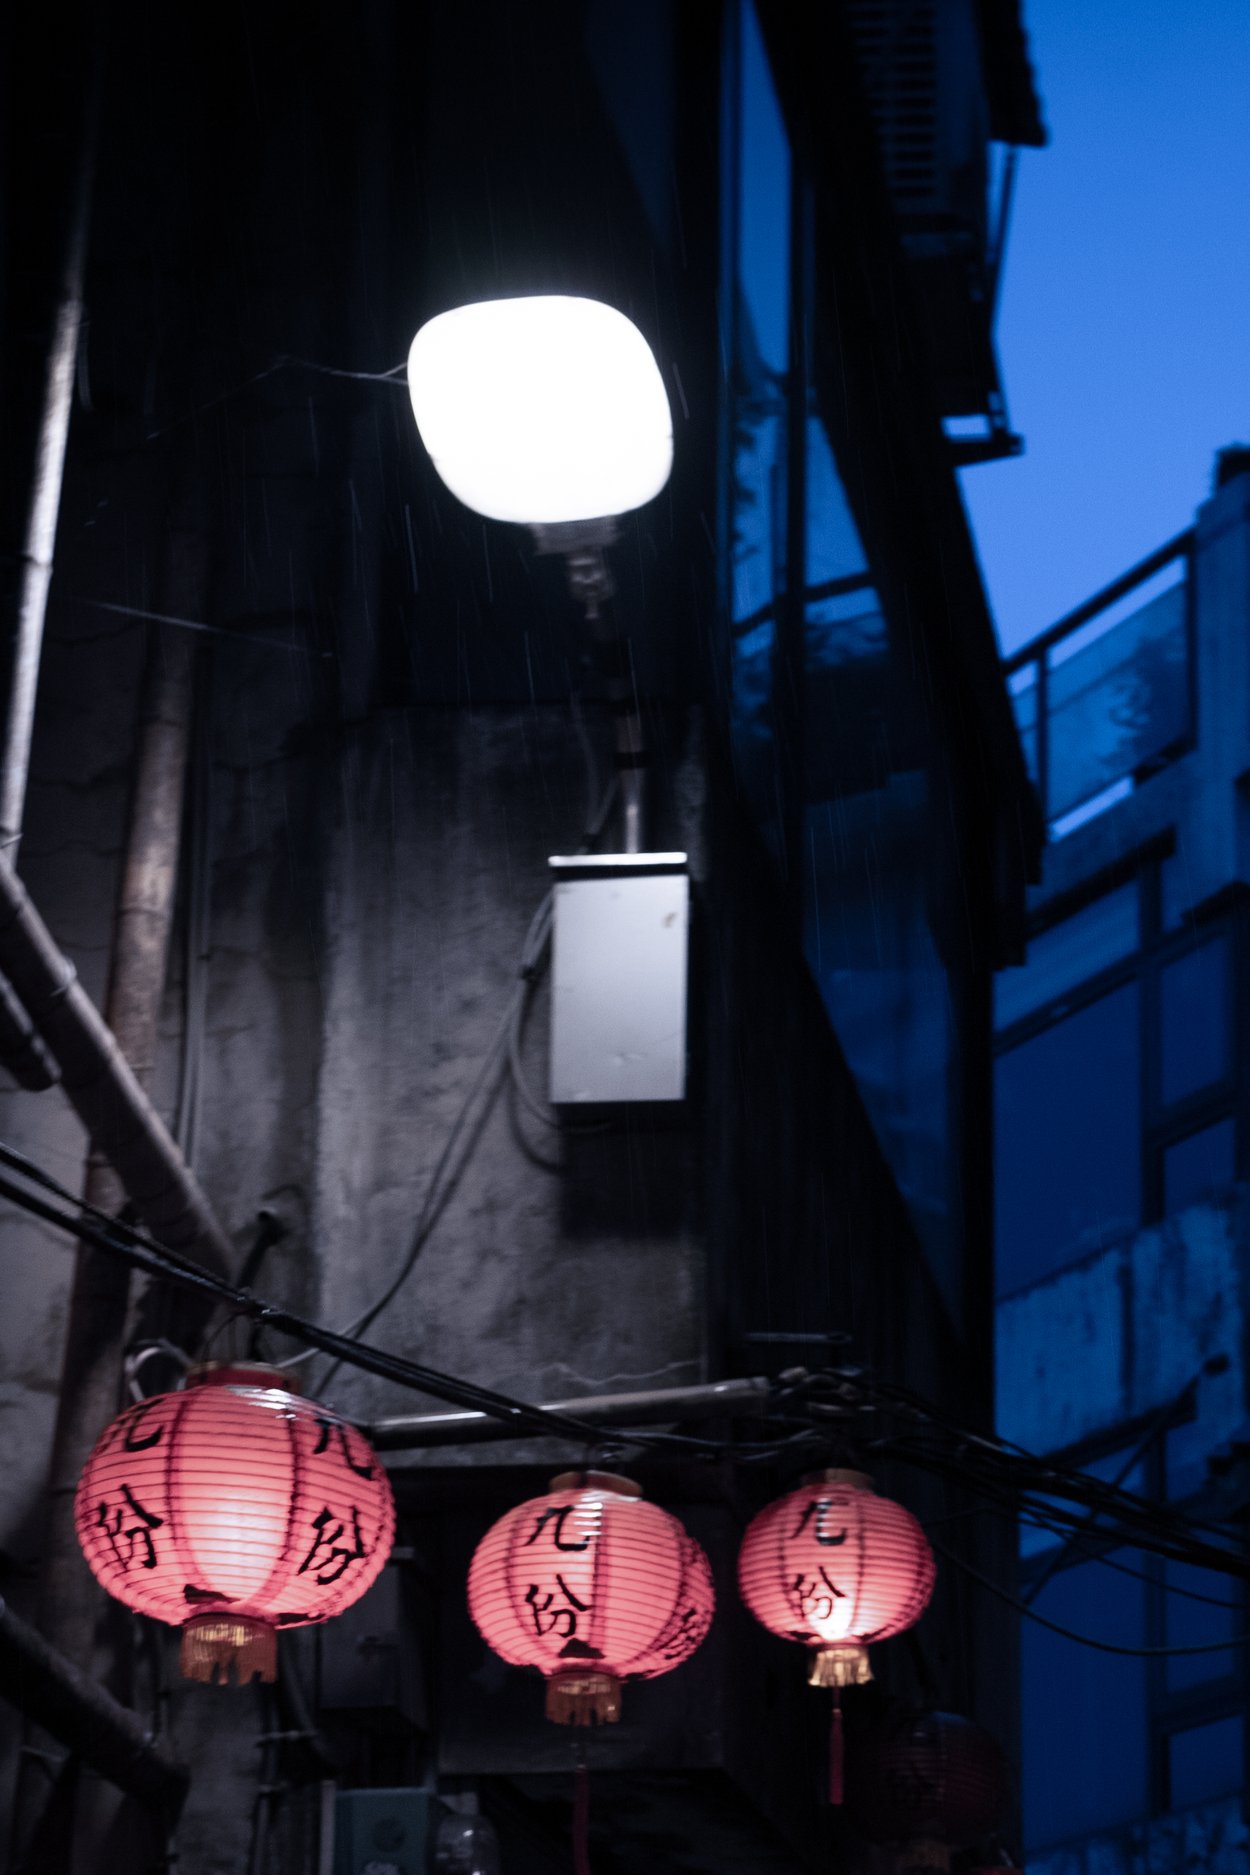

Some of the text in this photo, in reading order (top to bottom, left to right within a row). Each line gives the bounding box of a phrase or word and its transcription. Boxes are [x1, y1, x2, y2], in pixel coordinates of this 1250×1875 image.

[98, 1398, 165, 1569] 九份
[297, 1418, 373, 1586] 九份
[523, 1504, 594, 1640] 九份
[788, 1500, 848, 1620] 九份
